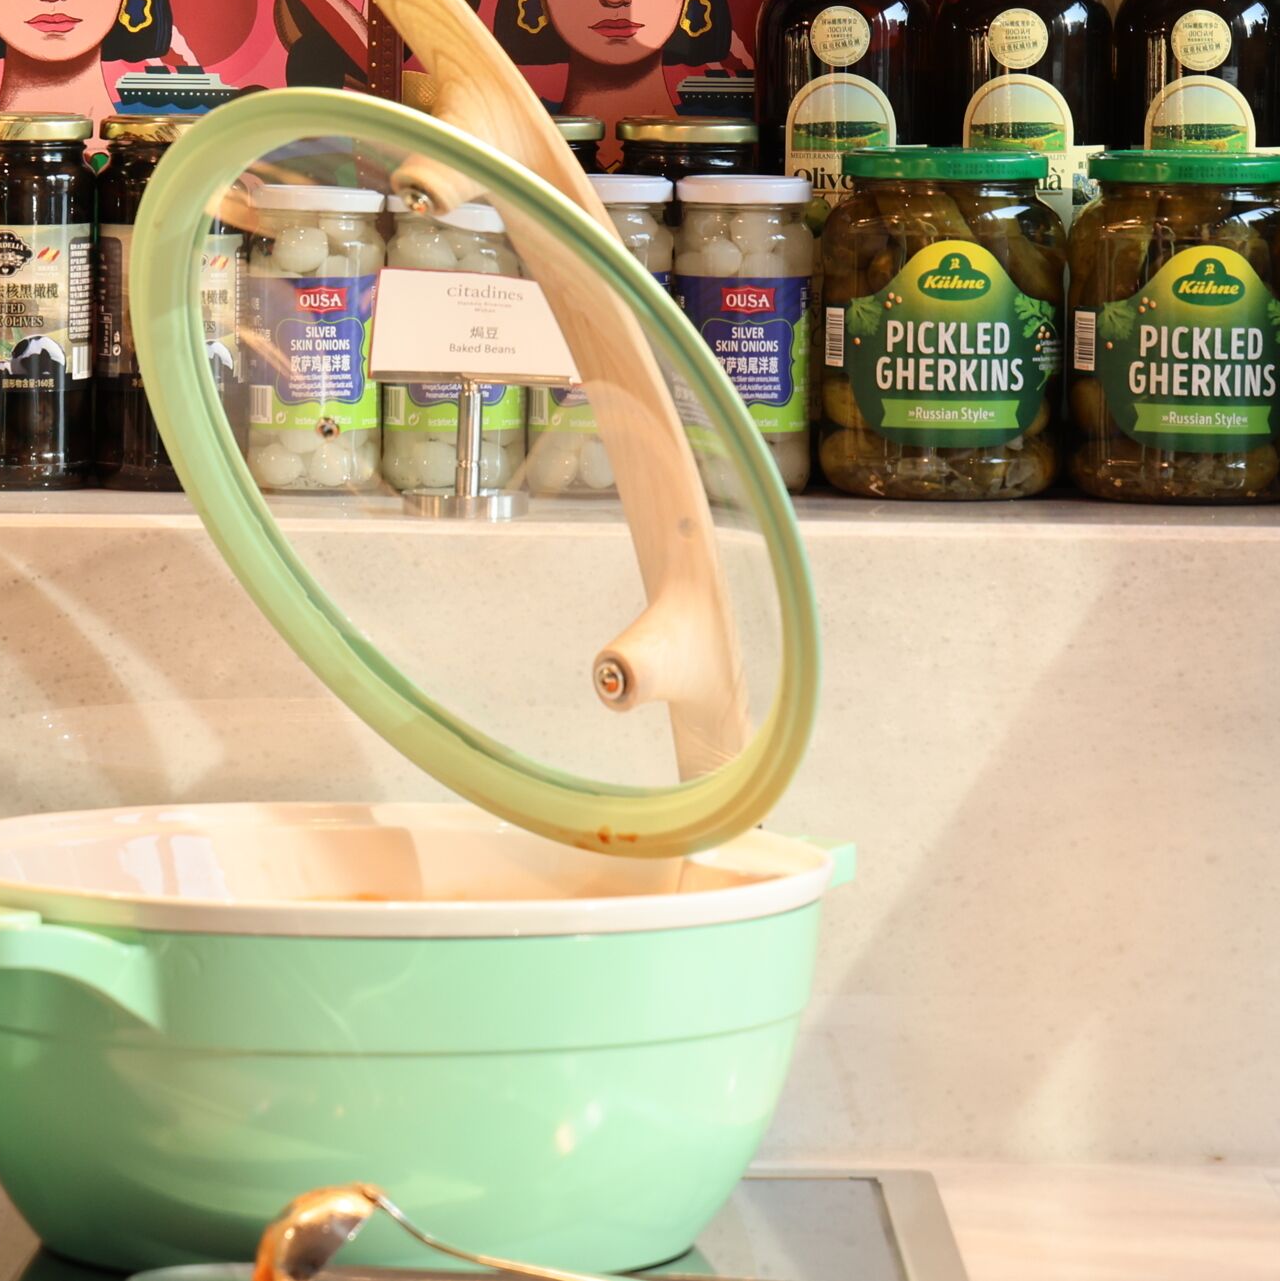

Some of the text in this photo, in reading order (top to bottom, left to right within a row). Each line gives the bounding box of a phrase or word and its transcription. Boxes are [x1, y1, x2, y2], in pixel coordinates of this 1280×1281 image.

[924, 275, 986, 290] Kühne
[1178, 280, 1240, 295] Kühne
[447, 284, 524, 301] citadines
[299, 293, 342, 307] OUSA
[726, 294, 770, 308] OUSA
[4, 315, 43, 328] OLIVES
[306, 326, 337, 338] SILVER
[470, 326, 499, 340] 焗豆
[732, 327, 764, 339] SILVER
[887, 320, 1011, 355] PICKLED
[290, 339, 351, 351] SKIN ONIONS
[449, 343, 517, 355] Baked Beans
[716, 340, 779, 353] SKIN ONIONS
[1140, 324, 1264, 360] PICKLED
[876, 357, 1025, 392] GHERKINS
[1128, 361, 1277, 398] GHERKINS
